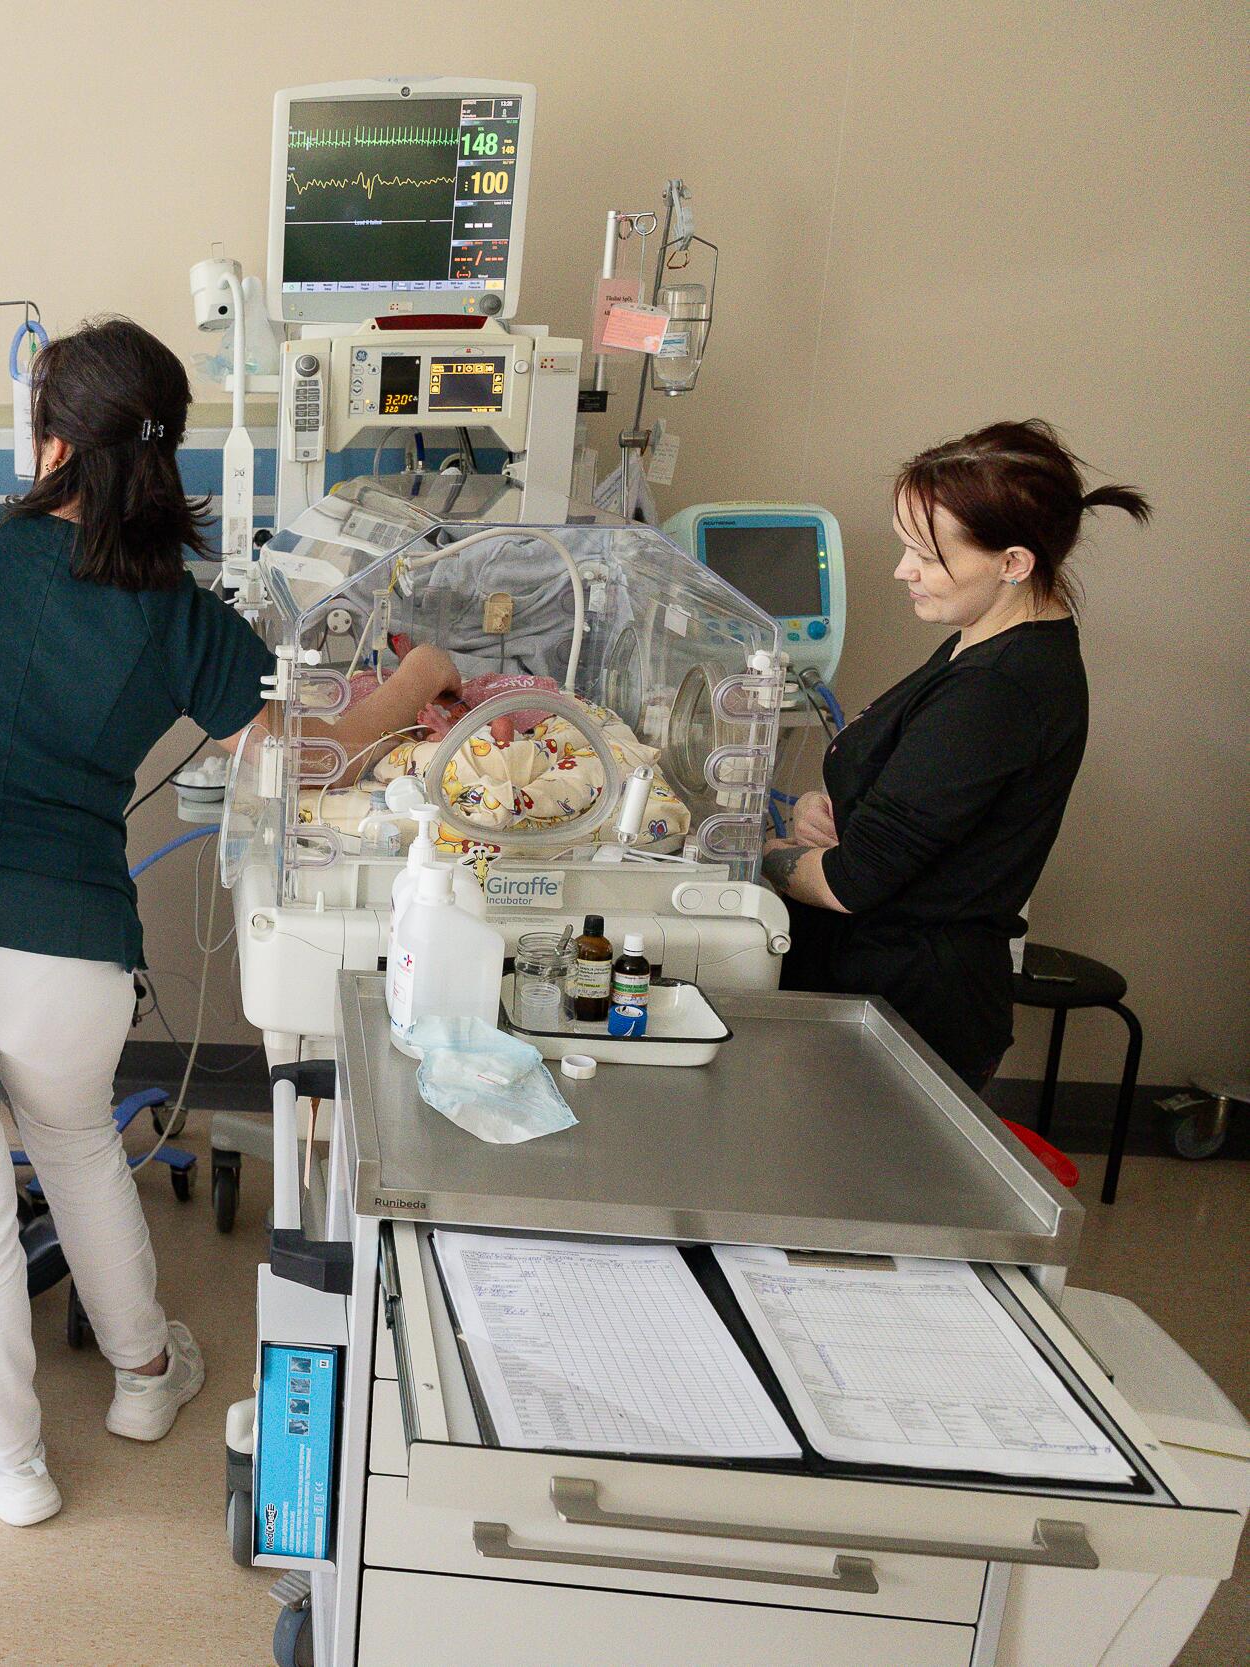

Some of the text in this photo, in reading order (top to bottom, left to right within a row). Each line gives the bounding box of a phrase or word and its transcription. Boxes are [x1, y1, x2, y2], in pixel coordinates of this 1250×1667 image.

[461, 133, 498, 156] 148
[471, 171, 509, 194] 100
[486, 876, 558, 895] Giraffe
[486, 896, 533, 905] Incubator
[374, 1197, 427, 1209] Runibeda
